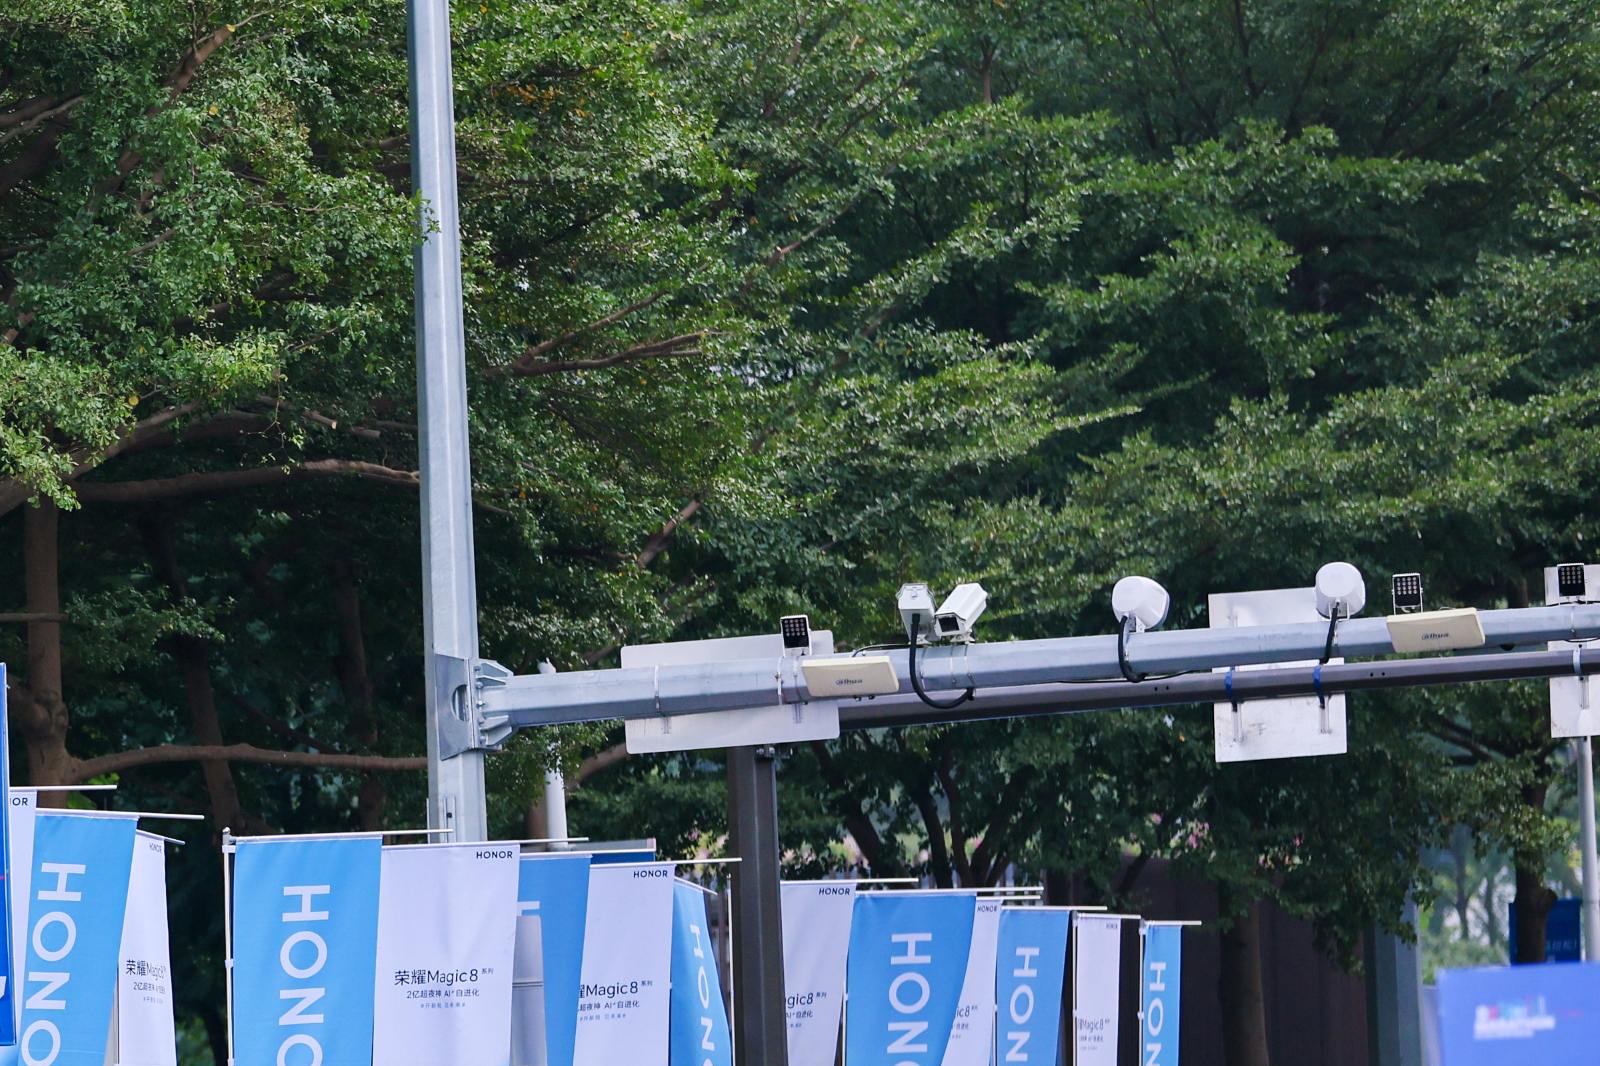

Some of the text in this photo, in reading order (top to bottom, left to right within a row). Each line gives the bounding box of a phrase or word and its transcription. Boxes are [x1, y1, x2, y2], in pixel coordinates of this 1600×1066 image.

[476, 850, 513, 859] HONOR
[633, 869, 669, 878] HONOR
[818, 887, 851, 896] HONOR
